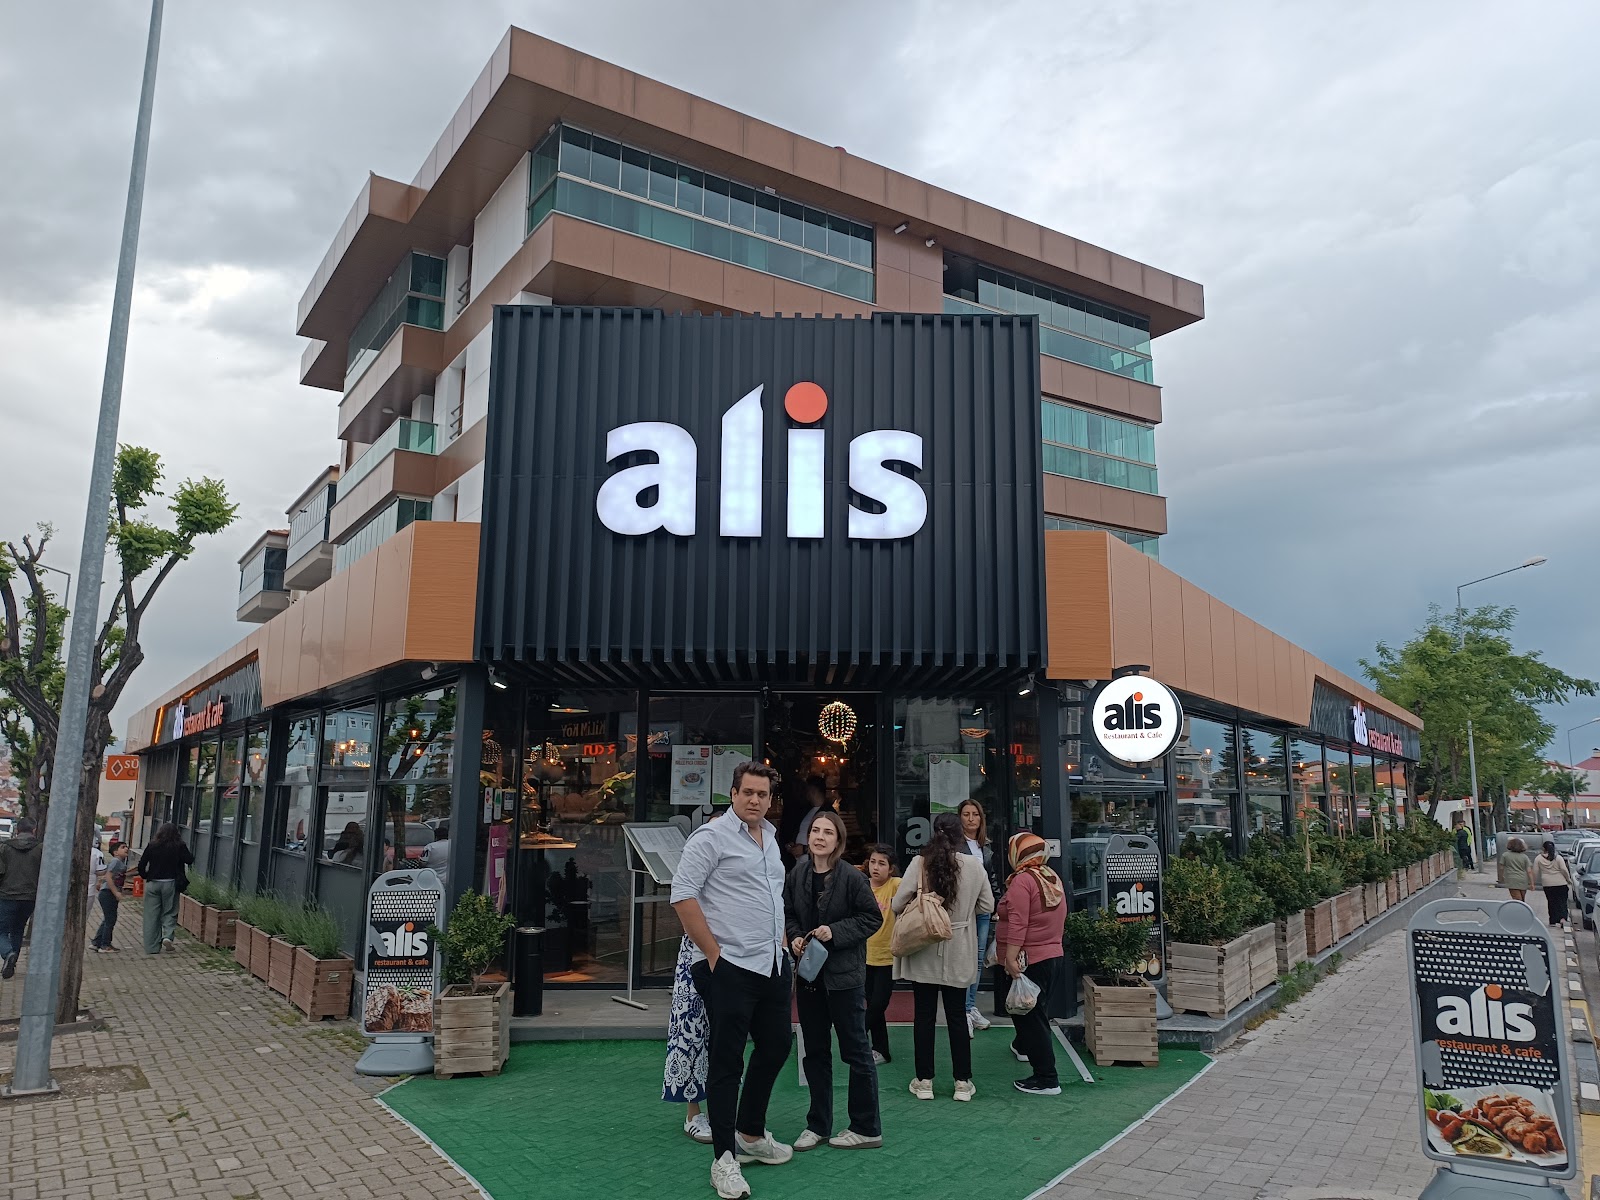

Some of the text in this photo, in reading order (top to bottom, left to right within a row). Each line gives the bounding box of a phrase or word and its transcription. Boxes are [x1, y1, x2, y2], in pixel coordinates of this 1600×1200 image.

[596, 381, 928, 539] alis
[1104, 692, 1161, 730] alis
[1103, 732, 1138, 740] Restaurant
[1147, 731, 1162, 739] Cafe
[124, 758, 139, 769] SÜ
[1116, 882, 1155, 914] alis
[377, 921, 428, 957] alis
[415, 958, 429, 966] cafe
[1436, 984, 1537, 1041] alis
[1501, 1044, 1512, 1055] &
[1514, 1046, 1542, 1058] cafe
